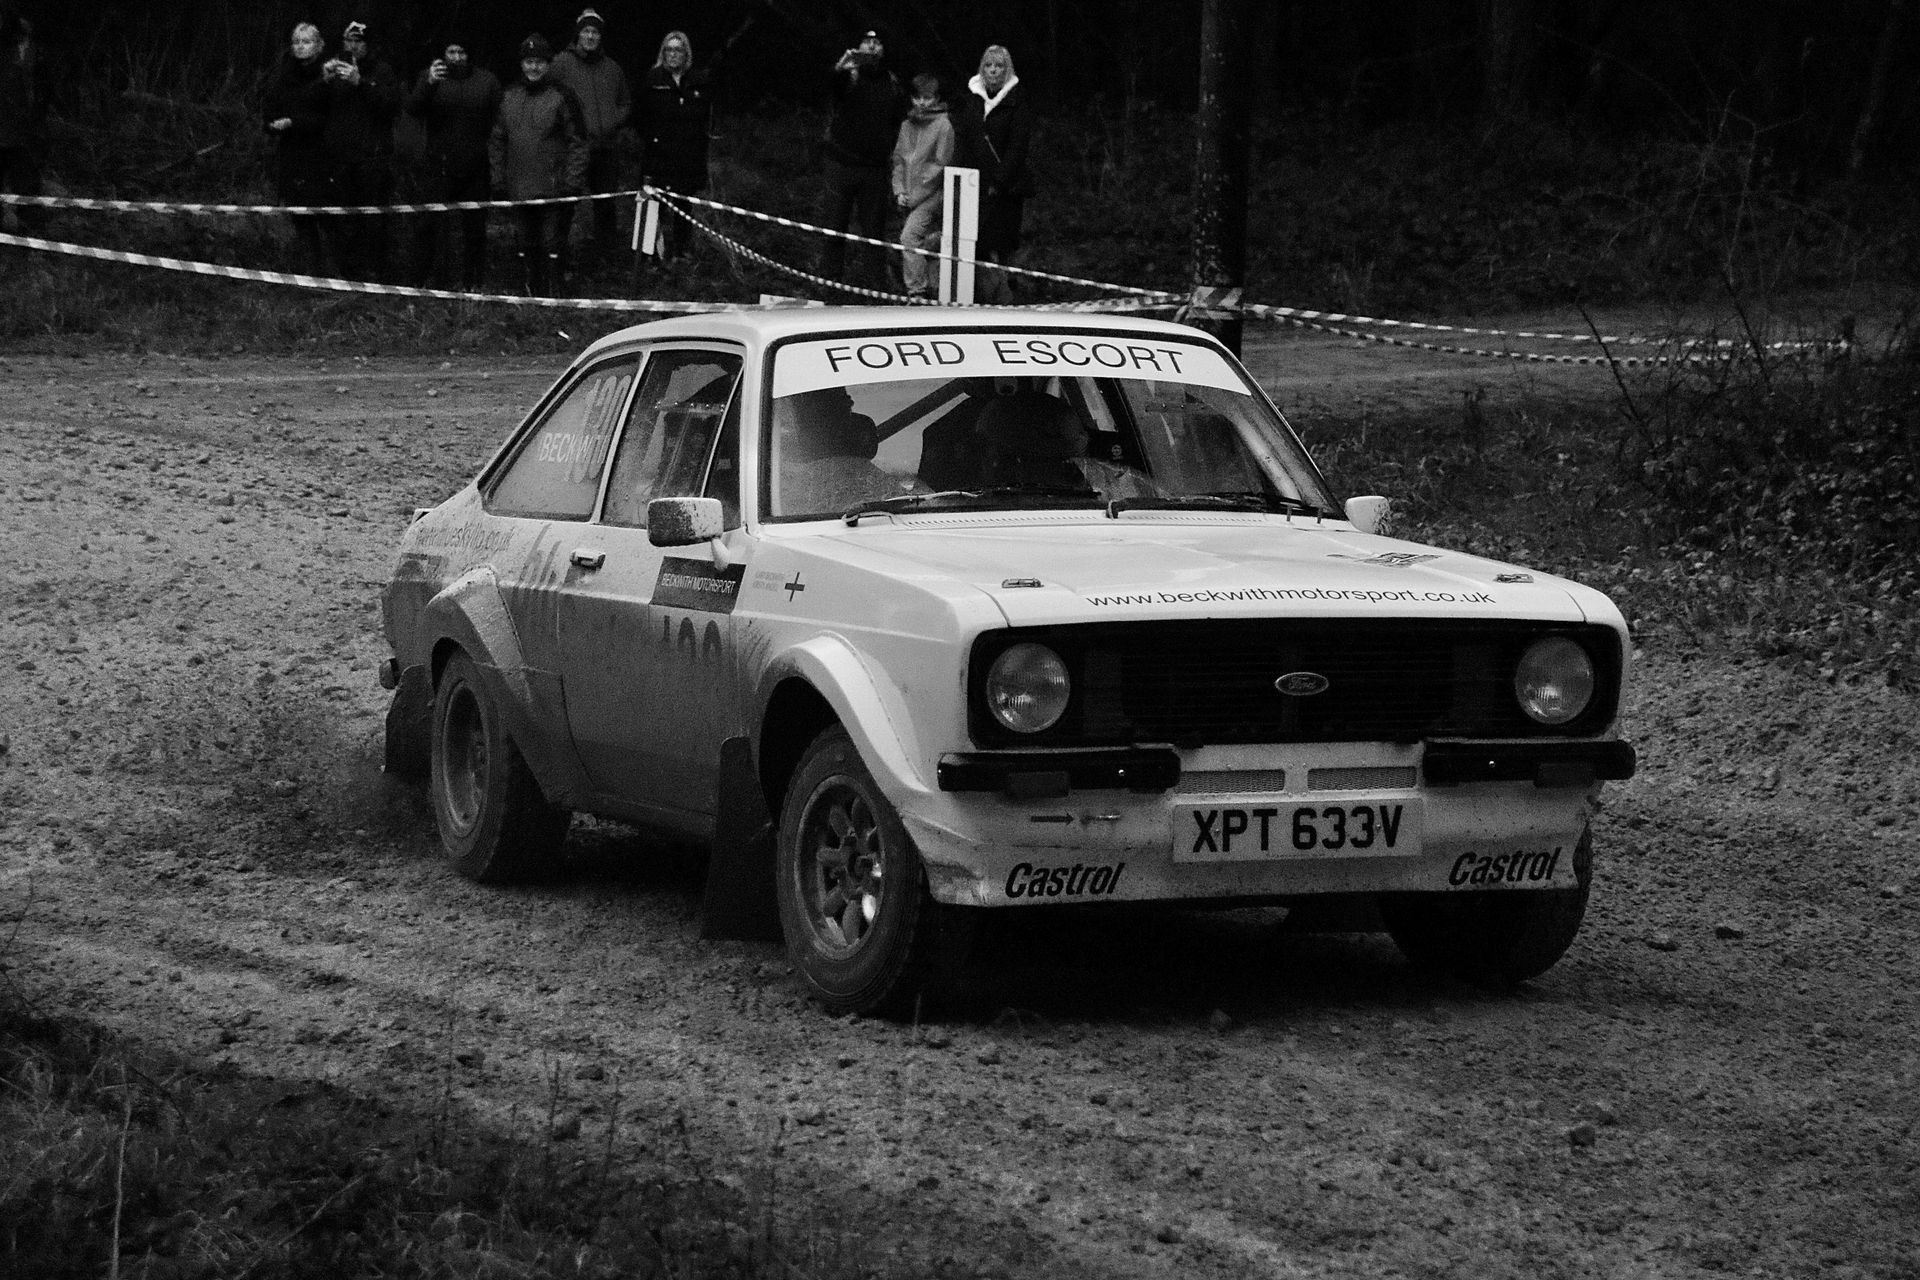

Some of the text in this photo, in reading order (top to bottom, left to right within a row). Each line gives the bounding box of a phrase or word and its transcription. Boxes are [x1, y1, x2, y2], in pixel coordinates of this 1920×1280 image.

[825, 339, 1183, 374] FORD ESCORT
[1086, 588, 1497, 606] www.beckwithmotorsport.co.uk
[1193, 804, 1403, 852] XPT 633V
[1004, 862, 1125, 898] Castrol
[1448, 846, 1562, 886] Castrol
